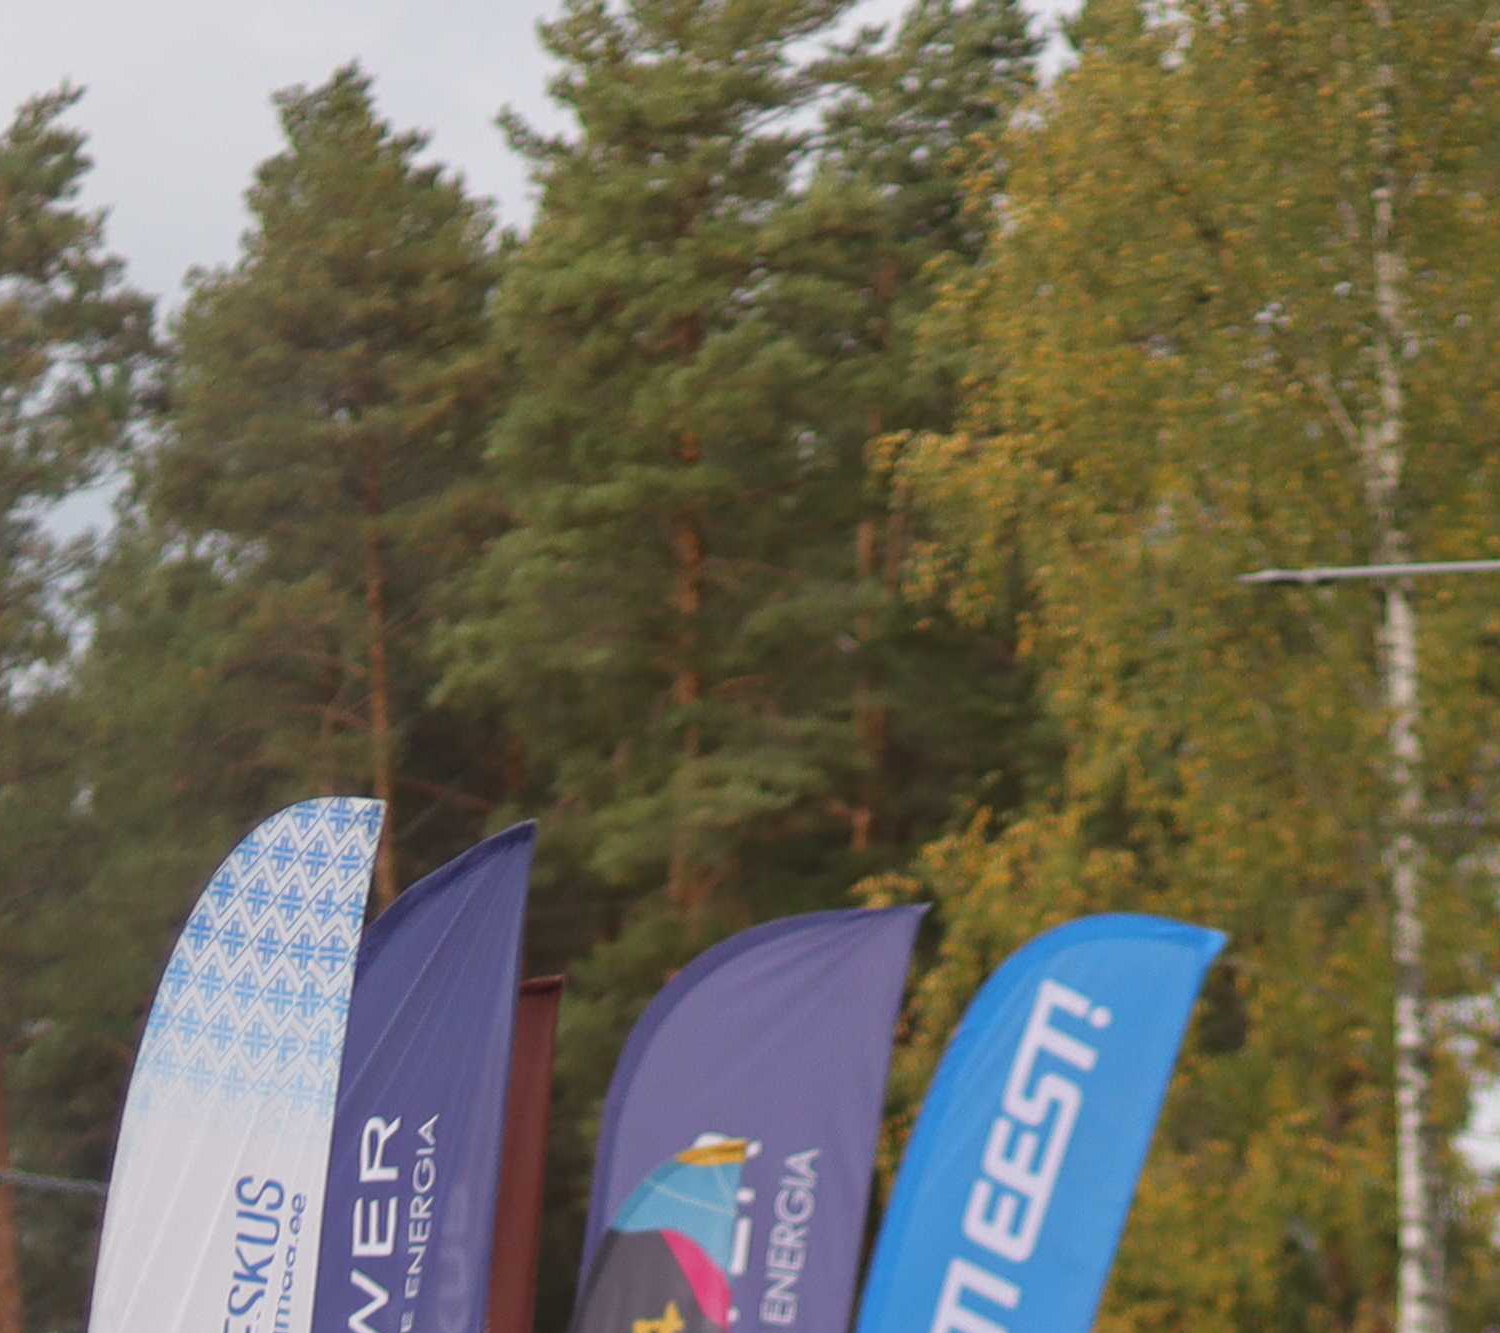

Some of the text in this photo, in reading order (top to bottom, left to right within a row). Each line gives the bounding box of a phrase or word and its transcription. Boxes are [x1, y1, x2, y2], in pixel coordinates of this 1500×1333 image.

[404, 1112, 440, 1299] ENERGIA
[964, 977, 1113, 1263] EEST!
[759, 1147, 821, 1322] ENERGIA
